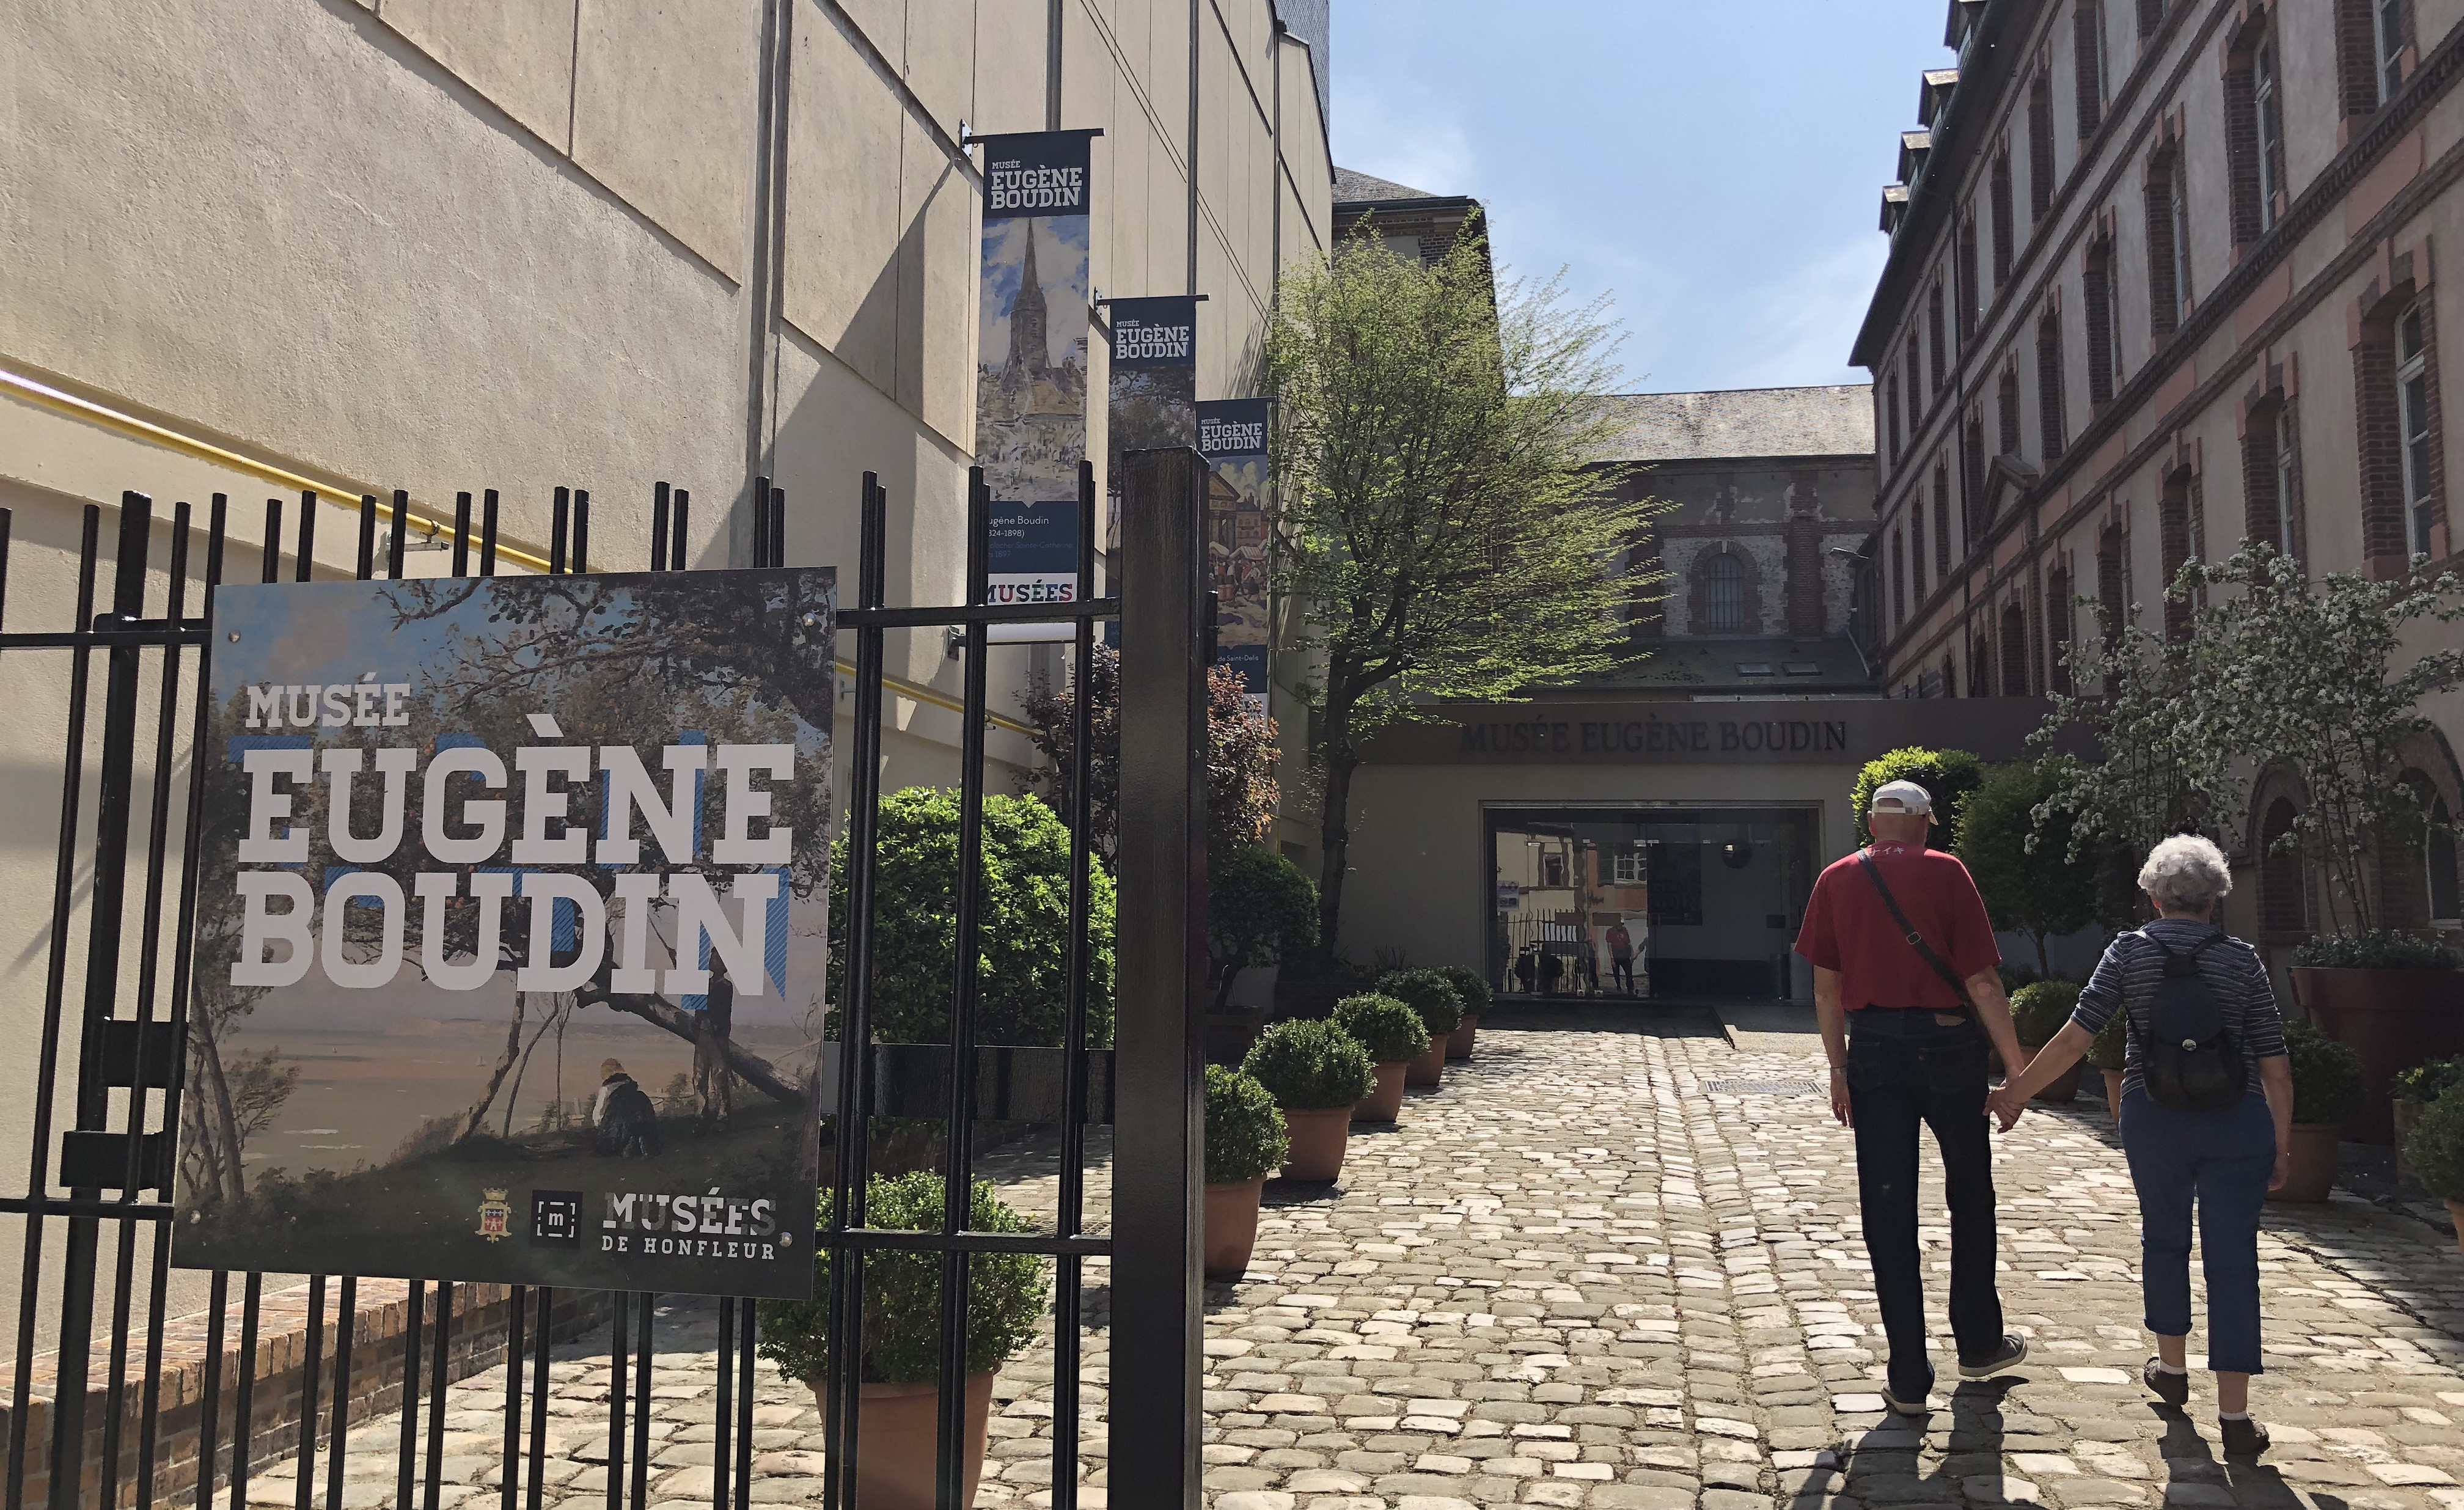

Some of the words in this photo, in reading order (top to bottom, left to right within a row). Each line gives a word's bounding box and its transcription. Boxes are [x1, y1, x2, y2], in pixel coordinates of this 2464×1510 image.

[992, 159, 1021, 169] MUSÉE
[991, 164, 1082, 190] EUGÈNE
[991, 187, 1080, 209] BOUDIN
[1116, 319, 1139, 328] MUSÉE
[1116, 323, 1189, 343] EUGÈNE
[1116, 342, 1187, 359] BOUDIN
[1201, 420, 1263, 439] EUGÈNE
[1201, 436, 1261, 452] BOUDIN
[989, 516, 1015, 527] ugène
[1018, 515, 1049, 524] Boudin
[989, 529, 1025, 538] 824-1898)
[245, 672, 410, 728] MUSÉE
[1460, 714, 1569, 753] MUSÉE
[1580, 713, 1709, 752] EUGÈNE
[1720, 721, 1847, 752] BOUDIN
[237, 713, 796, 865] EUGÈNE
[229, 870, 780, 997] BOUDIN
[602, 1187, 776, 1236] MUSÉES
[601, 1235, 628, 1253] DE
[644, 1237, 775, 1260] HONFLEUR
